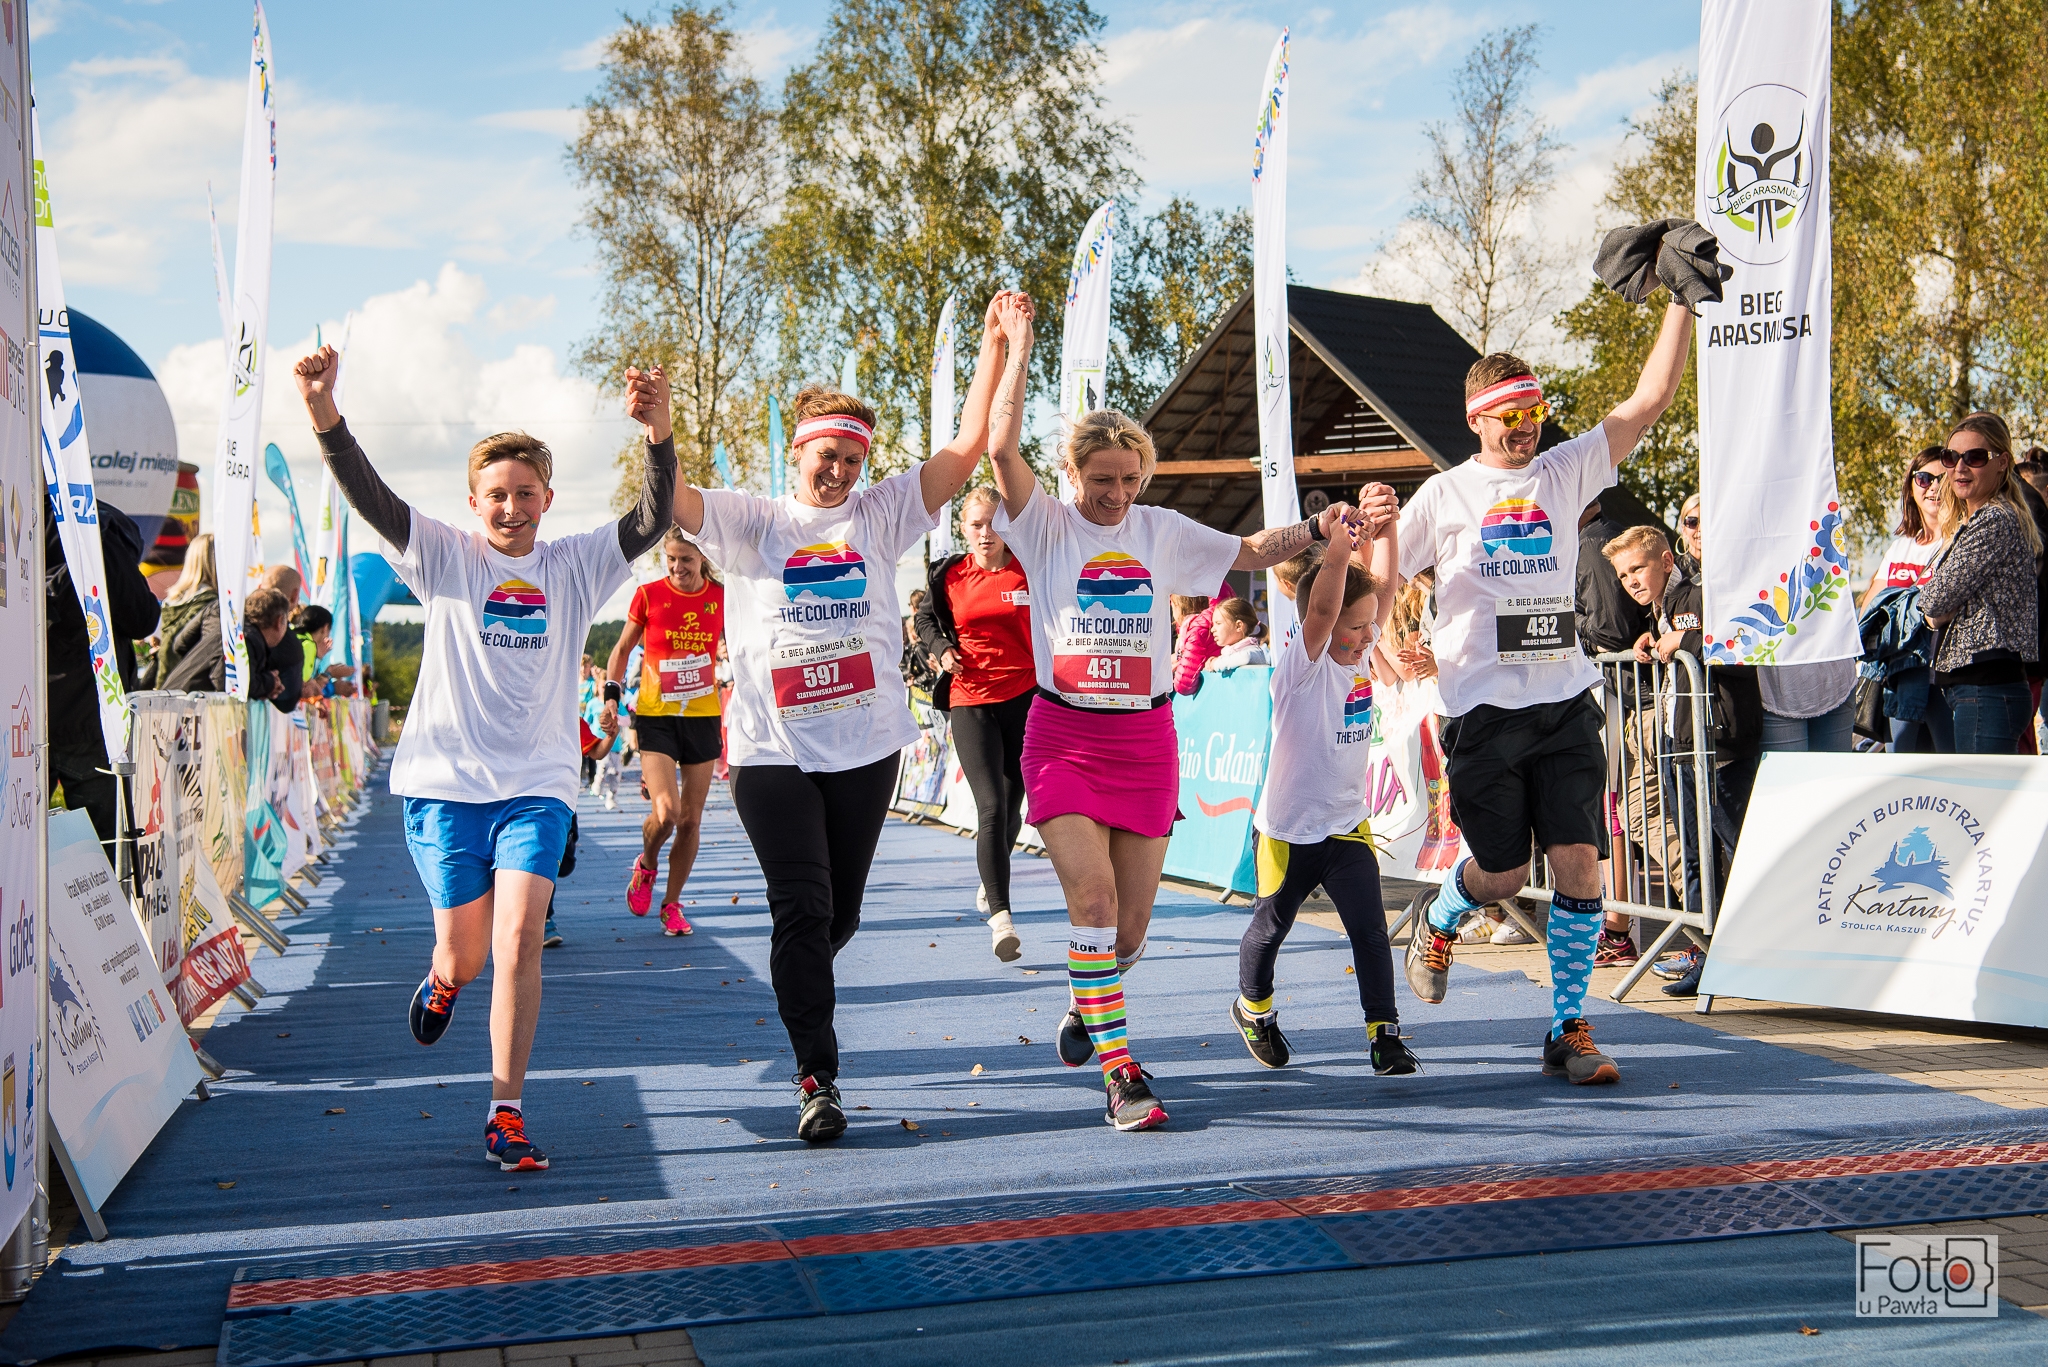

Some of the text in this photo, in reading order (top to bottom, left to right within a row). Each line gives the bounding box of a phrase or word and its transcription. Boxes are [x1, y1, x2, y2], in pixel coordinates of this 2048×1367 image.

[1732, 191, 1752, 210] BIEG
[1740, 290, 1783, 317] BIEG
[1708, 314, 1812, 348] ARASMUSA
[1479, 561, 1501, 577] THE
[1503, 559, 1537, 576] COLOR
[1516, 598, 1531, 606] BIEG
[1533, 596, 1562, 606] ARASMUSA
[779, 600, 870, 622] THE COLOR RUN
[1674, 613, 1697, 622] STAR
[1070, 617, 1093, 634] THE
[1095, 617, 1134, 634] COLOR
[1527, 615, 1558, 636] 432
[1675, 620, 1700, 630] WARS
[493, 634, 528, 648] COLOR
[665, 630, 713, 642] PRUSZCZ
[1066, 638, 1132, 647] 2. BIEG ARASMUSA
[673, 640, 706, 652] BIEGA
[781, 640, 845, 659] 2. BIEG ARASMUSA
[677, 669, 700, 684] 595
[803, 662, 839, 688] 597
[1086, 657, 1121, 679] 431
[796, 682, 854, 700] SZATKOWSKA KAMILA
[1336, 731, 1352, 744] THE
[1818, 795, 1994, 937] PATRONAT BURMISTRZA KARTUZ
[1556, 895, 1573, 908] THE
[1843, 884, 1957, 940] Kartuzy
[1840, 921, 1928, 935] STOLICA KASZUB
